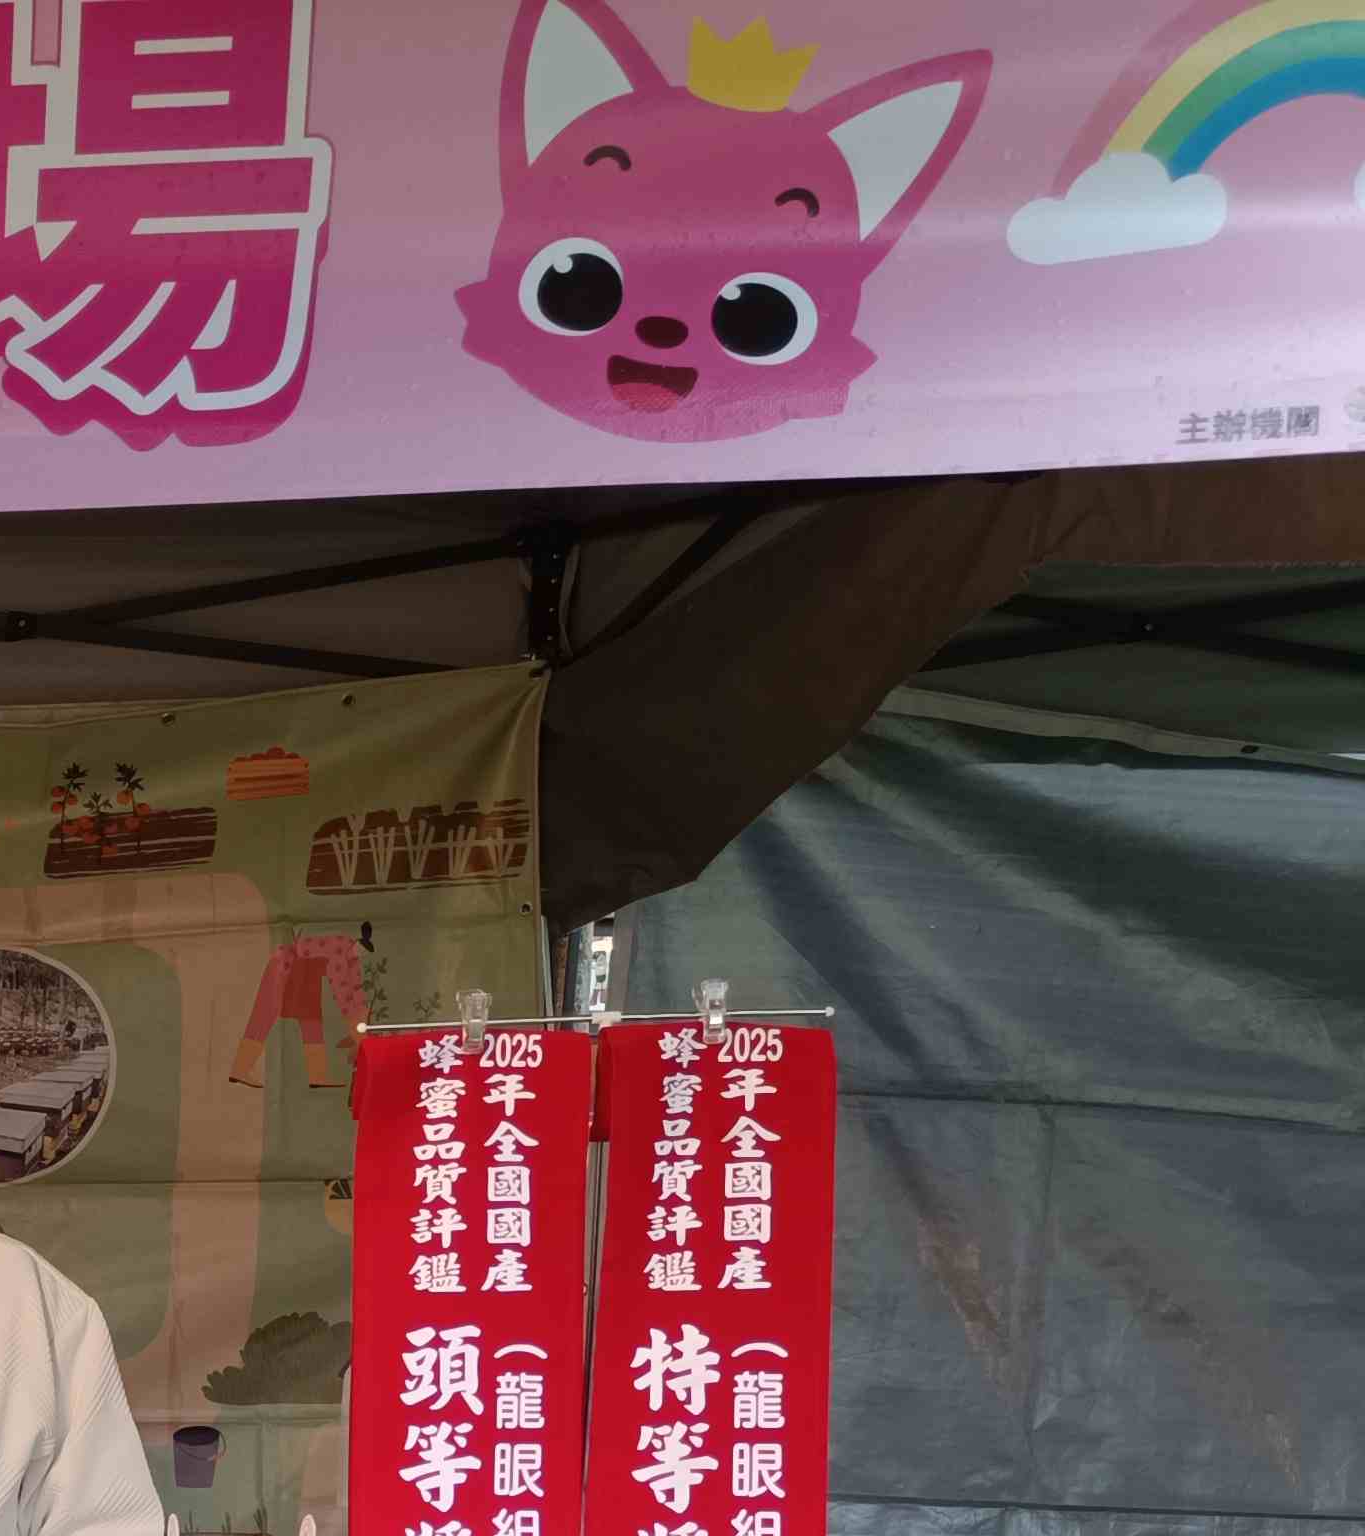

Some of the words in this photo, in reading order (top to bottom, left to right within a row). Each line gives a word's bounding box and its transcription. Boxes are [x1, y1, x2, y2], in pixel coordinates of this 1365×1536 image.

[408, 1034, 468, 1294] 蜂蜜品質評鑑
[644, 1027, 708, 1293] 蜂蜜品質評鑑
